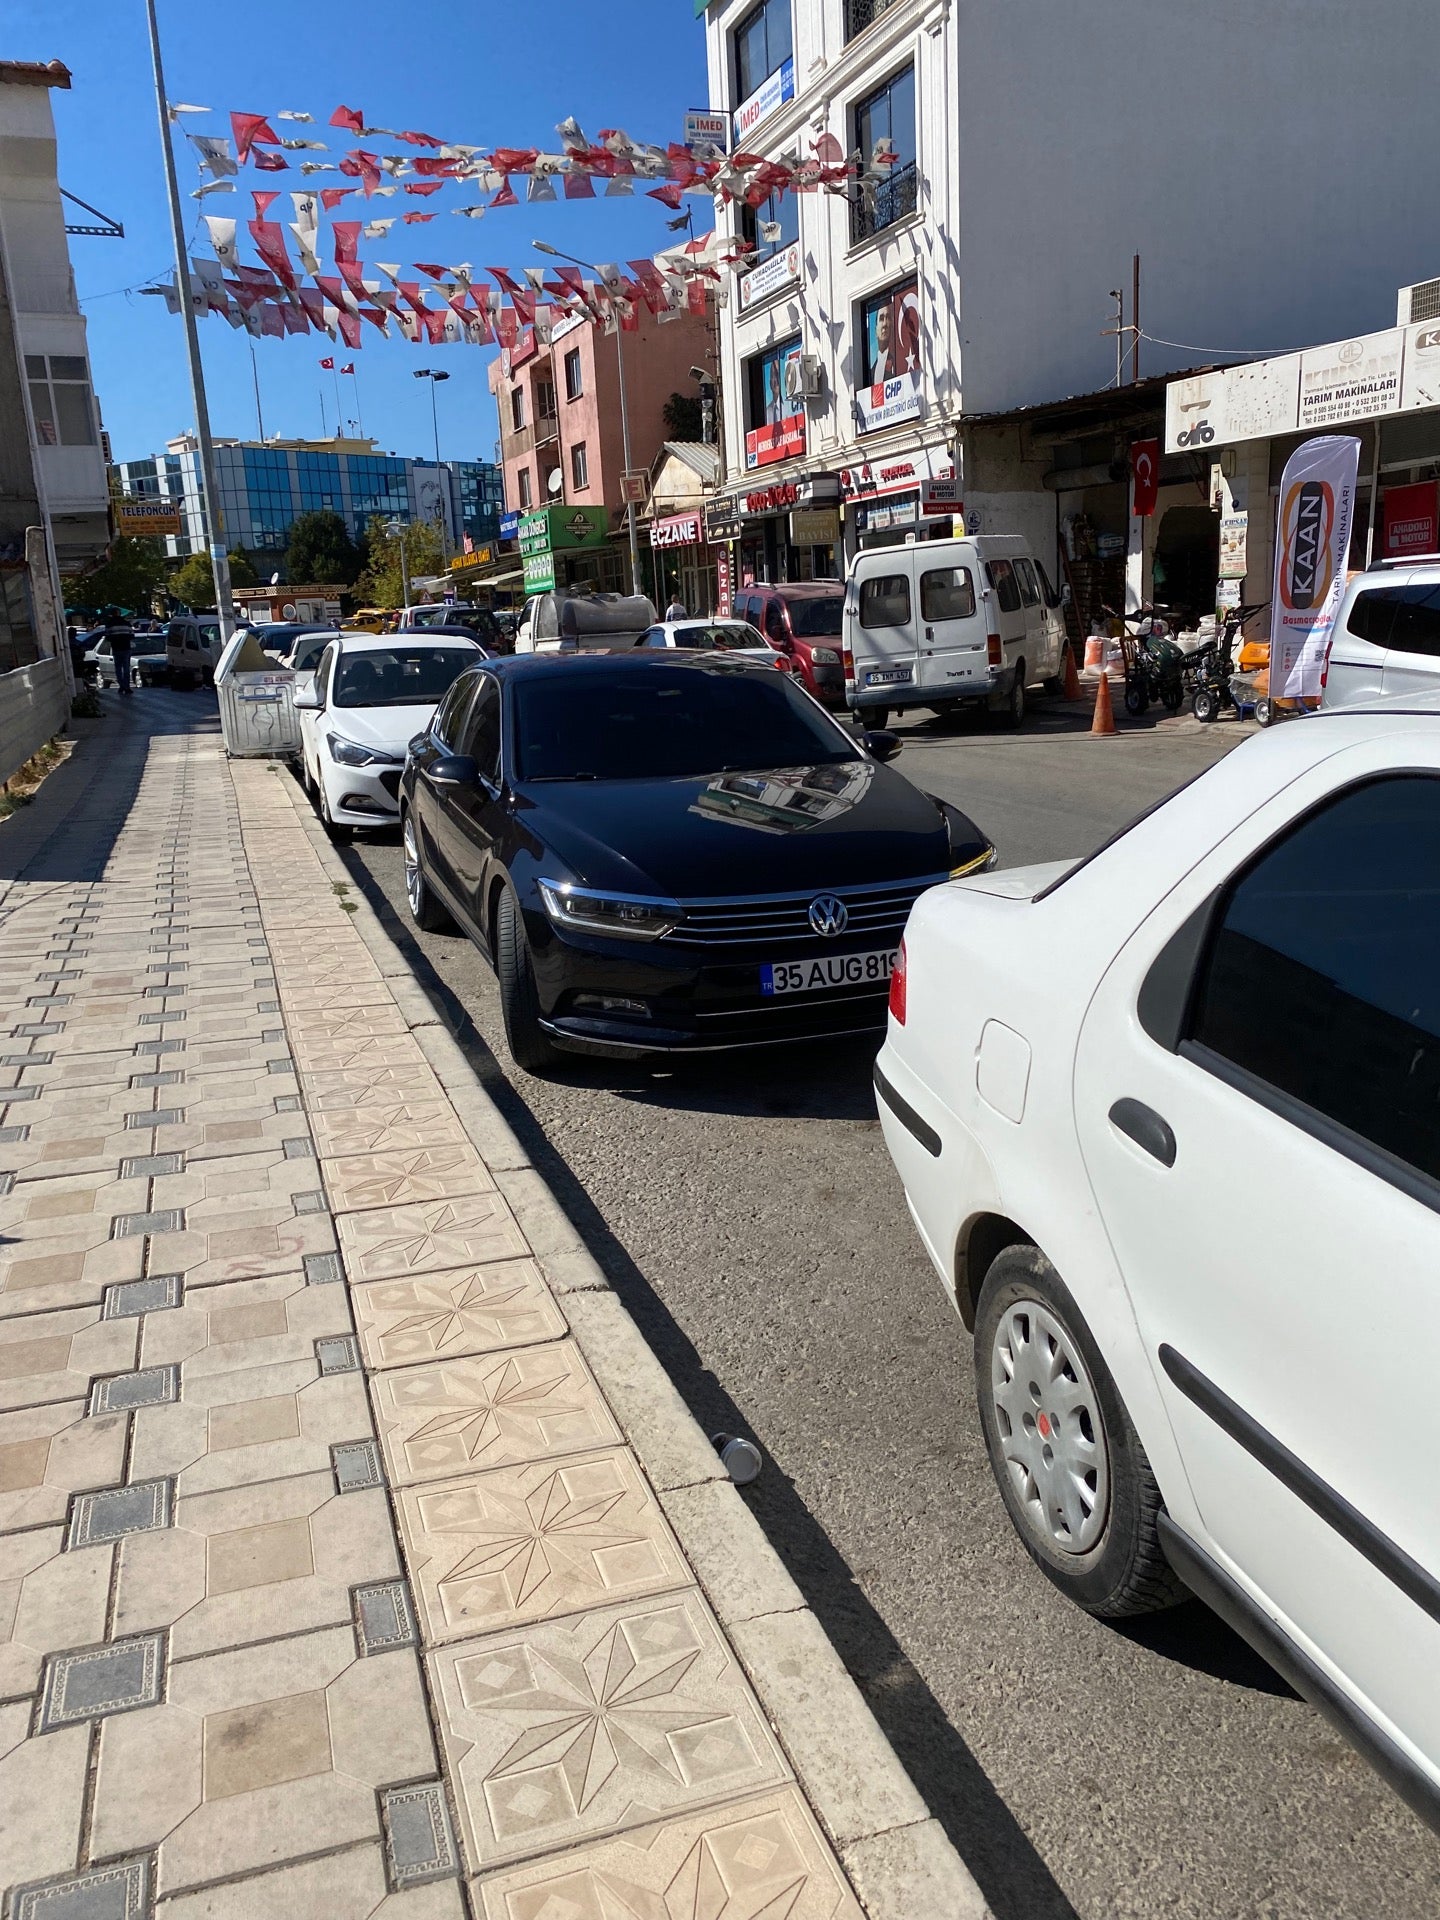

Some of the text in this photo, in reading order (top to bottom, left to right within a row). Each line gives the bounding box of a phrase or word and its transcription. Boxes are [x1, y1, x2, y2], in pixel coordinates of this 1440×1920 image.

[696, 117, 723, 131] İMED
[885, 380, 902, 400] CHP
[1303, 378, 1397, 406] TARIM MAKİNALARI
[931, 483, 955, 491] ANADOLU
[121, 506, 176, 517] TELEFONCUM
[649, 520, 696, 547] ECZANE
[1393, 520, 1430, 535] ANADOLU
[1400, 531, 1430, 544] MOTOR
[1293, 495, 1320, 594] KAAN
[1332, 485, 1350, 604] TARIM MAKİNALARI
[719, 550, 729, 615] eczan
[762, 951, 898, 991] TR 35 AUG 819
